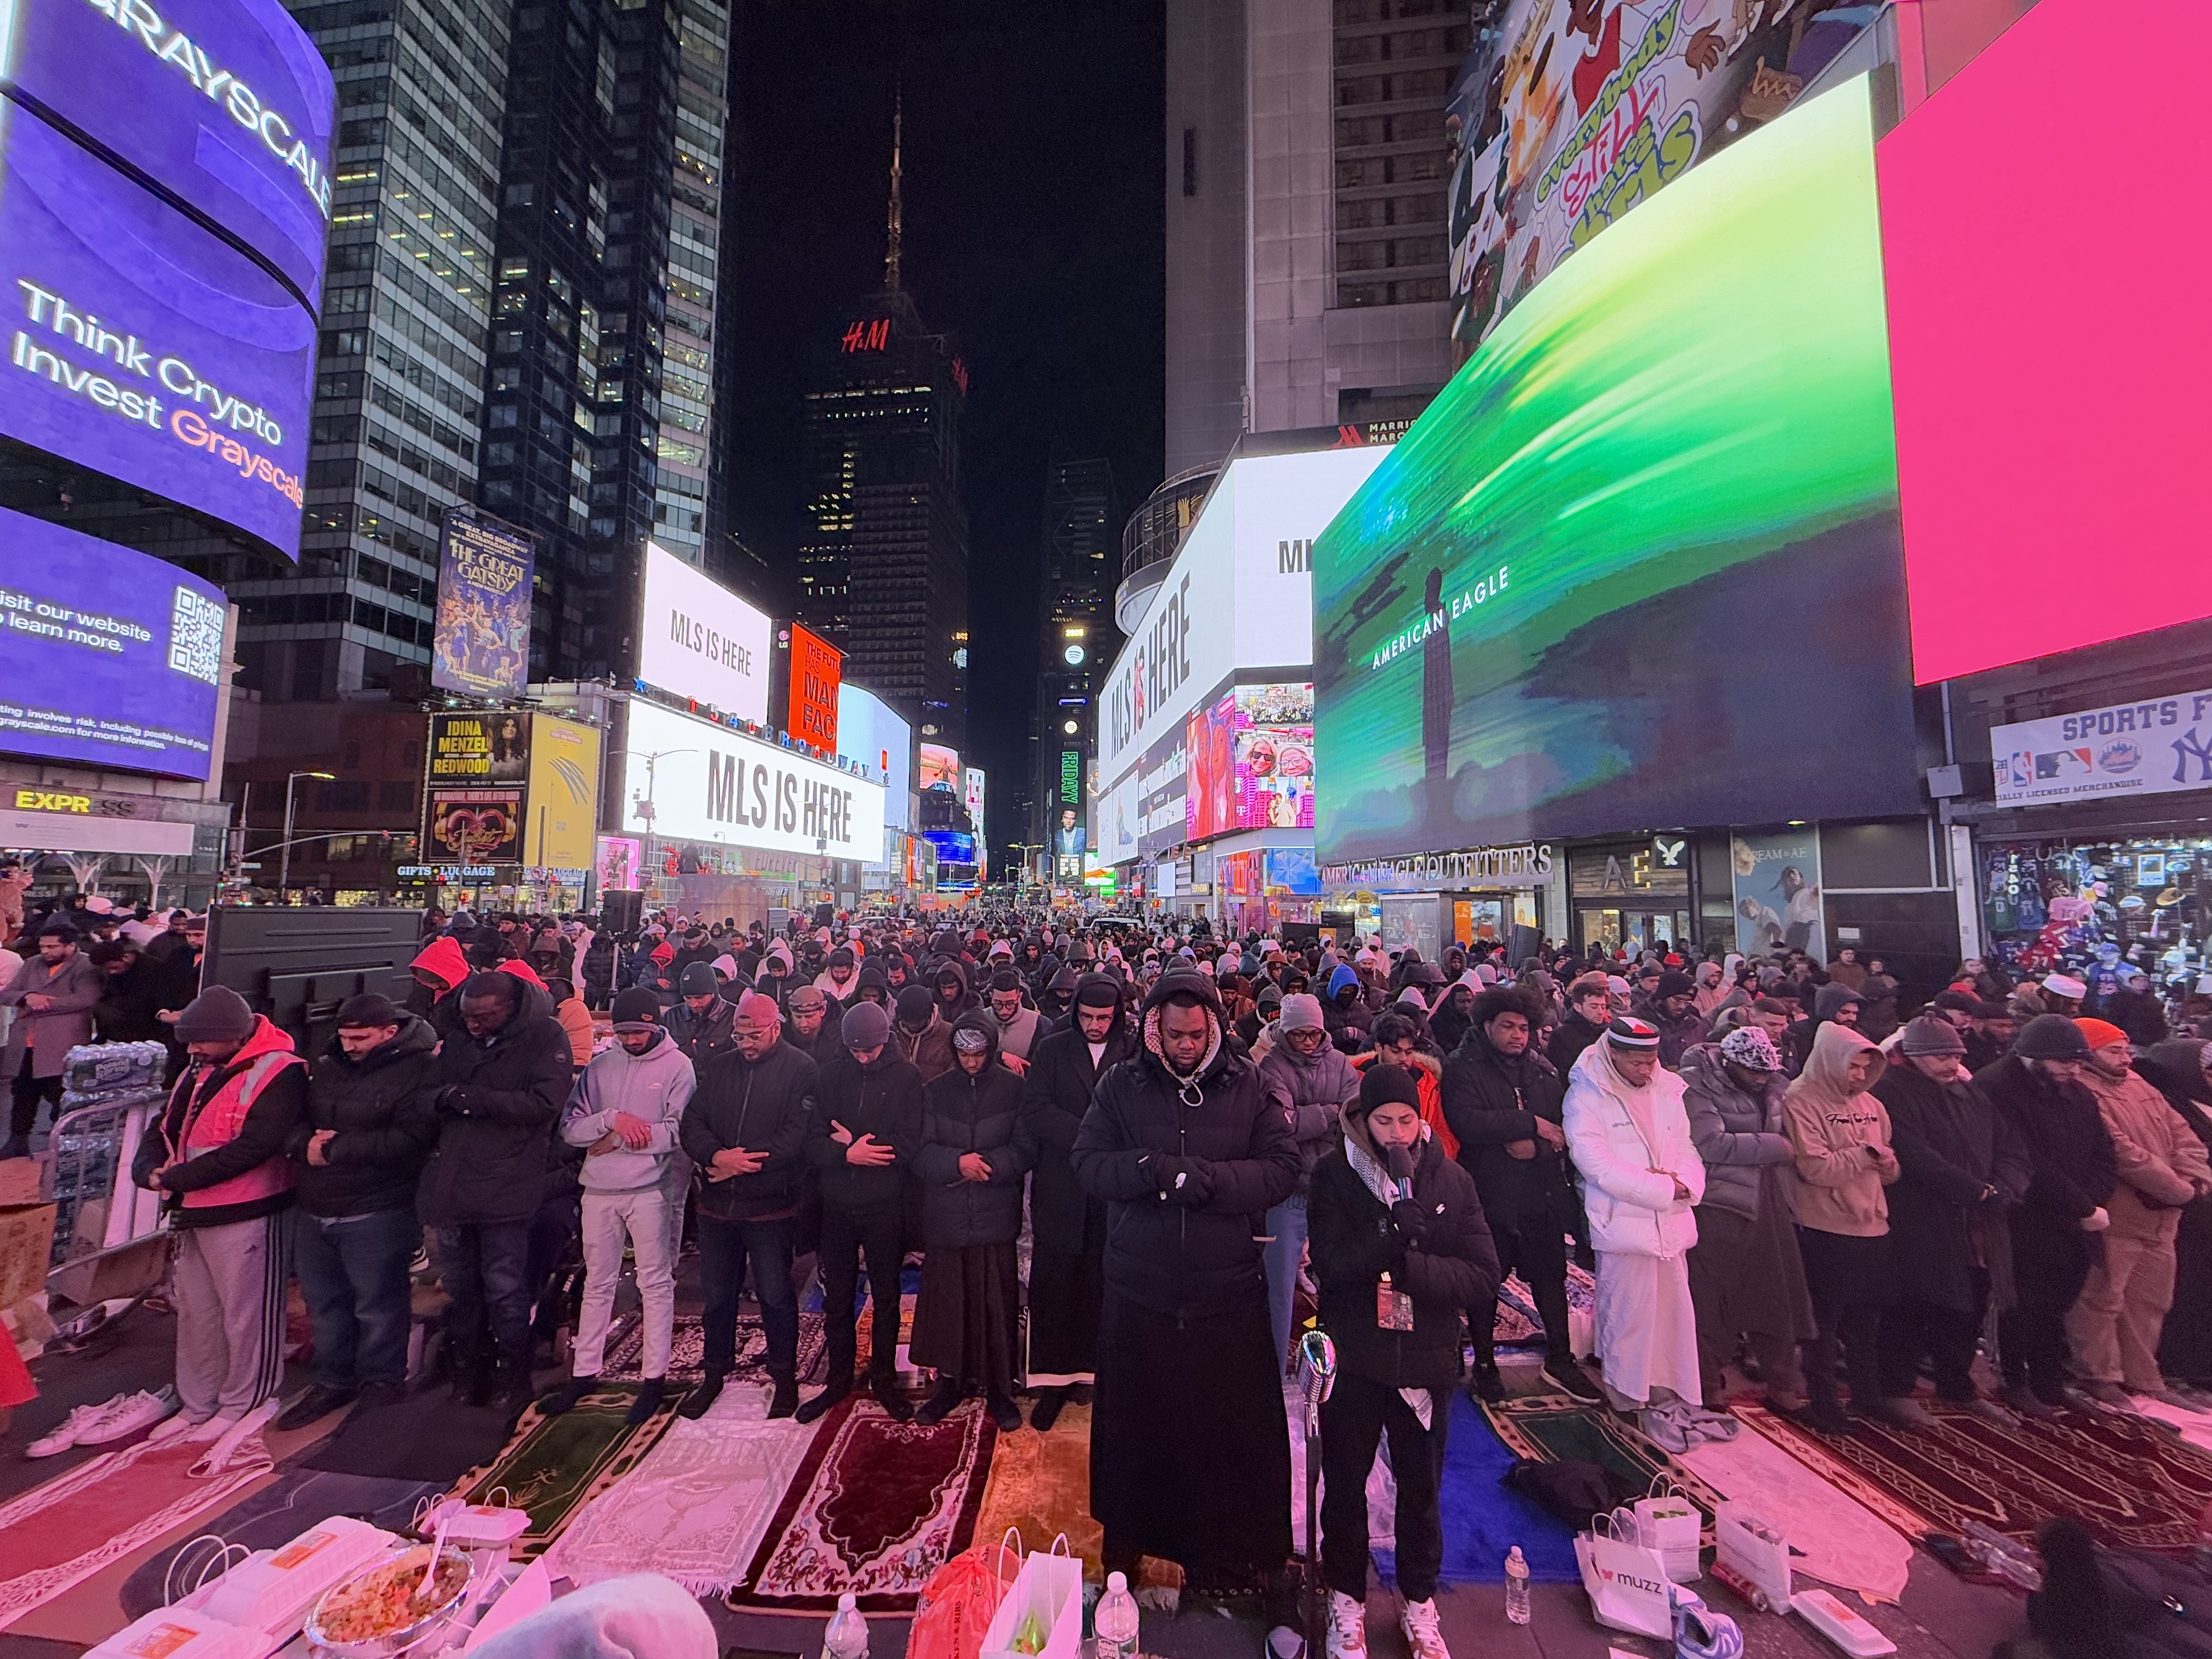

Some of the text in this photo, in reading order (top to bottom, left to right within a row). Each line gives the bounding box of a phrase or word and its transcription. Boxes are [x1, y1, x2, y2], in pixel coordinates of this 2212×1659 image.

[1537, 0, 1680, 202] everybody
[1584, 115, 1651, 217] hates
[842, 318, 890, 353] H&M
[18, 278, 282, 445] Think Crypto
[13, 331, 304, 509] Invest Grayscale
[458, 521, 482, 535] GREAT,
[482, 531, 494, 540] BIG
[494, 534, 529, 554] BROADWAY
[466, 531, 516, 555] EXTRAVAGANZA
[450, 540, 526, 582] THE GREAT
[458, 562, 516, 592] GATSBY
[8, 612, 63, 638] learn
[67, 629, 123, 653] more.
[35, 603, 75, 622] our
[76, 613, 151, 642] website
[1372, 566, 1509, 670] AMERICAN EAGLE
[671, 609, 752, 677] MLS IS HERE
[805, 640, 821, 661] THE
[805, 654, 820, 674] HAS
[1111, 667, 1131, 763] MLS
[1150, 569, 1190, 719] HERE
[0, 705, 23, 718] ting
[27, 709, 72, 724] involves
[100, 721, 142, 737] including
[0, 717, 75, 735] grayscale.com
[77, 728, 93, 737] for
[93, 731, 119, 742] more
[447, 720, 482, 736] IDINA
[803, 702, 837, 744] FAC
[2063, 701, 2178, 741] SPORTS
[438, 737, 488, 753] MENZEL
[433, 759, 490, 774] REDWOOD
[1062, 752, 1079, 804] FRIDAYY
[707, 749, 852, 843] MLS IS HERE
[2027, 786, 2070, 798] LICENSED
[2073, 778, 2143, 793] MERCHANDISE
[755, 851, 797, 872] FOREVER
[1322, 844, 1552, 886] AMERICAN EAGLE OUTFITTERS
[1790, 848, 1808, 859] AE
[397, 866, 432, 877] GIFTS
[552, 867, 587, 877] LUGGAGE
[95, 1058, 129, 1070] Poland
[1617, 1573, 1663, 1594] muzz
[953, 1600, 962, 1623] RIBS
